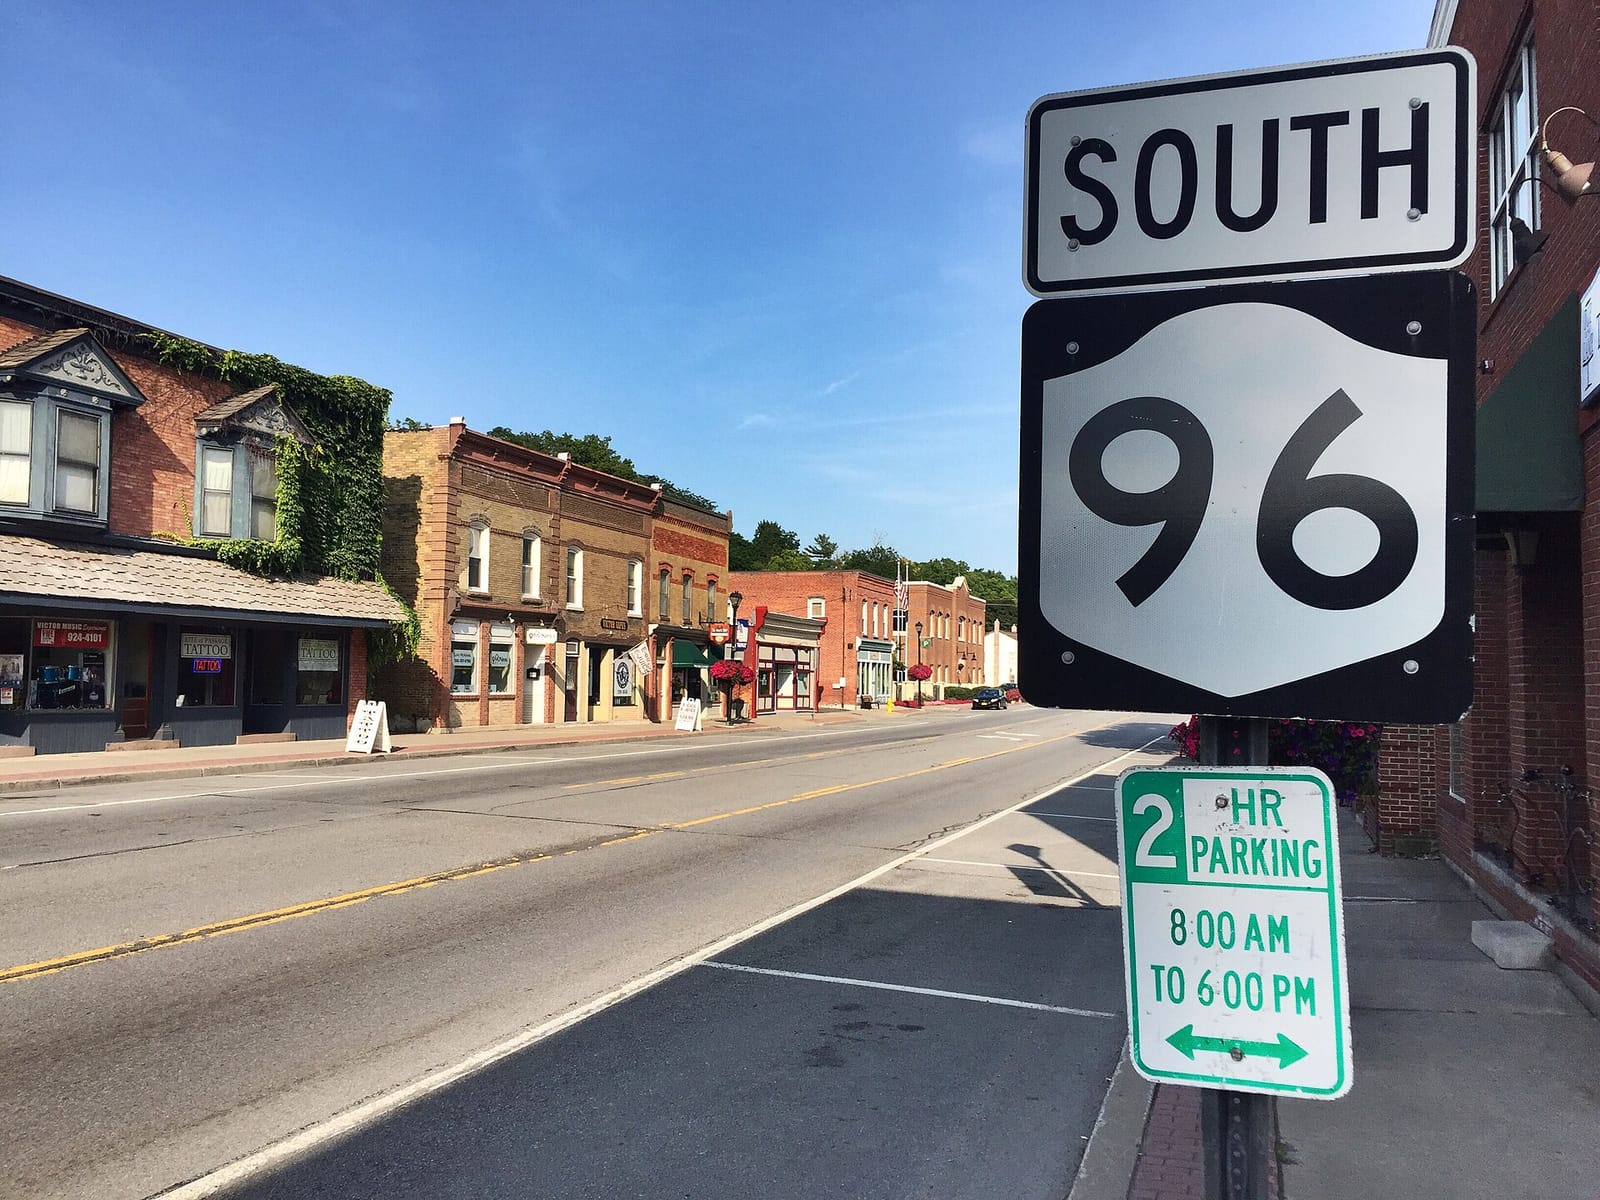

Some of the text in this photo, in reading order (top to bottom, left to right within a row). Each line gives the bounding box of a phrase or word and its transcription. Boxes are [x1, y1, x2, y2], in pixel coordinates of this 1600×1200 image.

[1060, 102, 1430, 247] SOUTH
[1069, 387, 1419, 611] 96
[37, 622, 60, 630] VICTOR
[62, 623, 82, 631] MUSIC
[67, 632, 102, 643] 924-4101
[184, 644, 228, 655] TATTOO
[196, 660, 220, 671] TATTOO
[301, 647, 336, 659] TATTOO
[1231, 787, 1283, 827] HR
[1132, 793, 1177, 869] 2
[1191, 835, 1322, 879] PARKING
[1170, 908, 1291, 953] 8:00 AM
[1150, 964, 1185, 1005] TO
[1272, 974, 1317, 1017] PM
